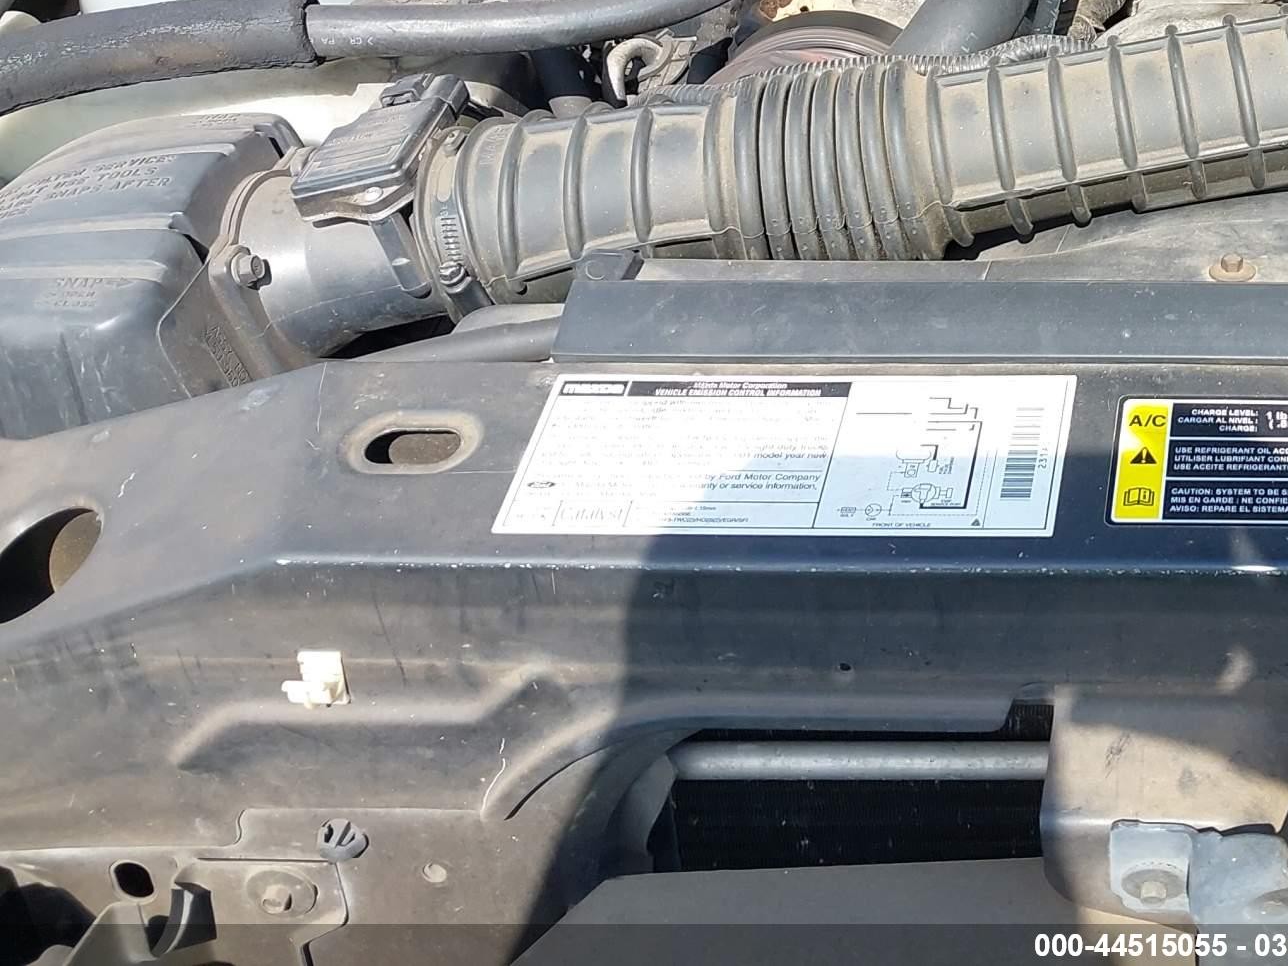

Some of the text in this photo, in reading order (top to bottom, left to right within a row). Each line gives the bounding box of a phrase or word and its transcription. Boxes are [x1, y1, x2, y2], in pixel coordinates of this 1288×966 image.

[655, 388, 822, 397] VEHICLE EMISSION CONTROL INFORMATION
[1266, 411, 1271, 419] 1
[1276, 412, 1287, 421] lb
[1129, 414, 1168, 428] A/C
[704, 473, 822, 482] by Ford Motor Company
[730, 482, 764, 490] service
